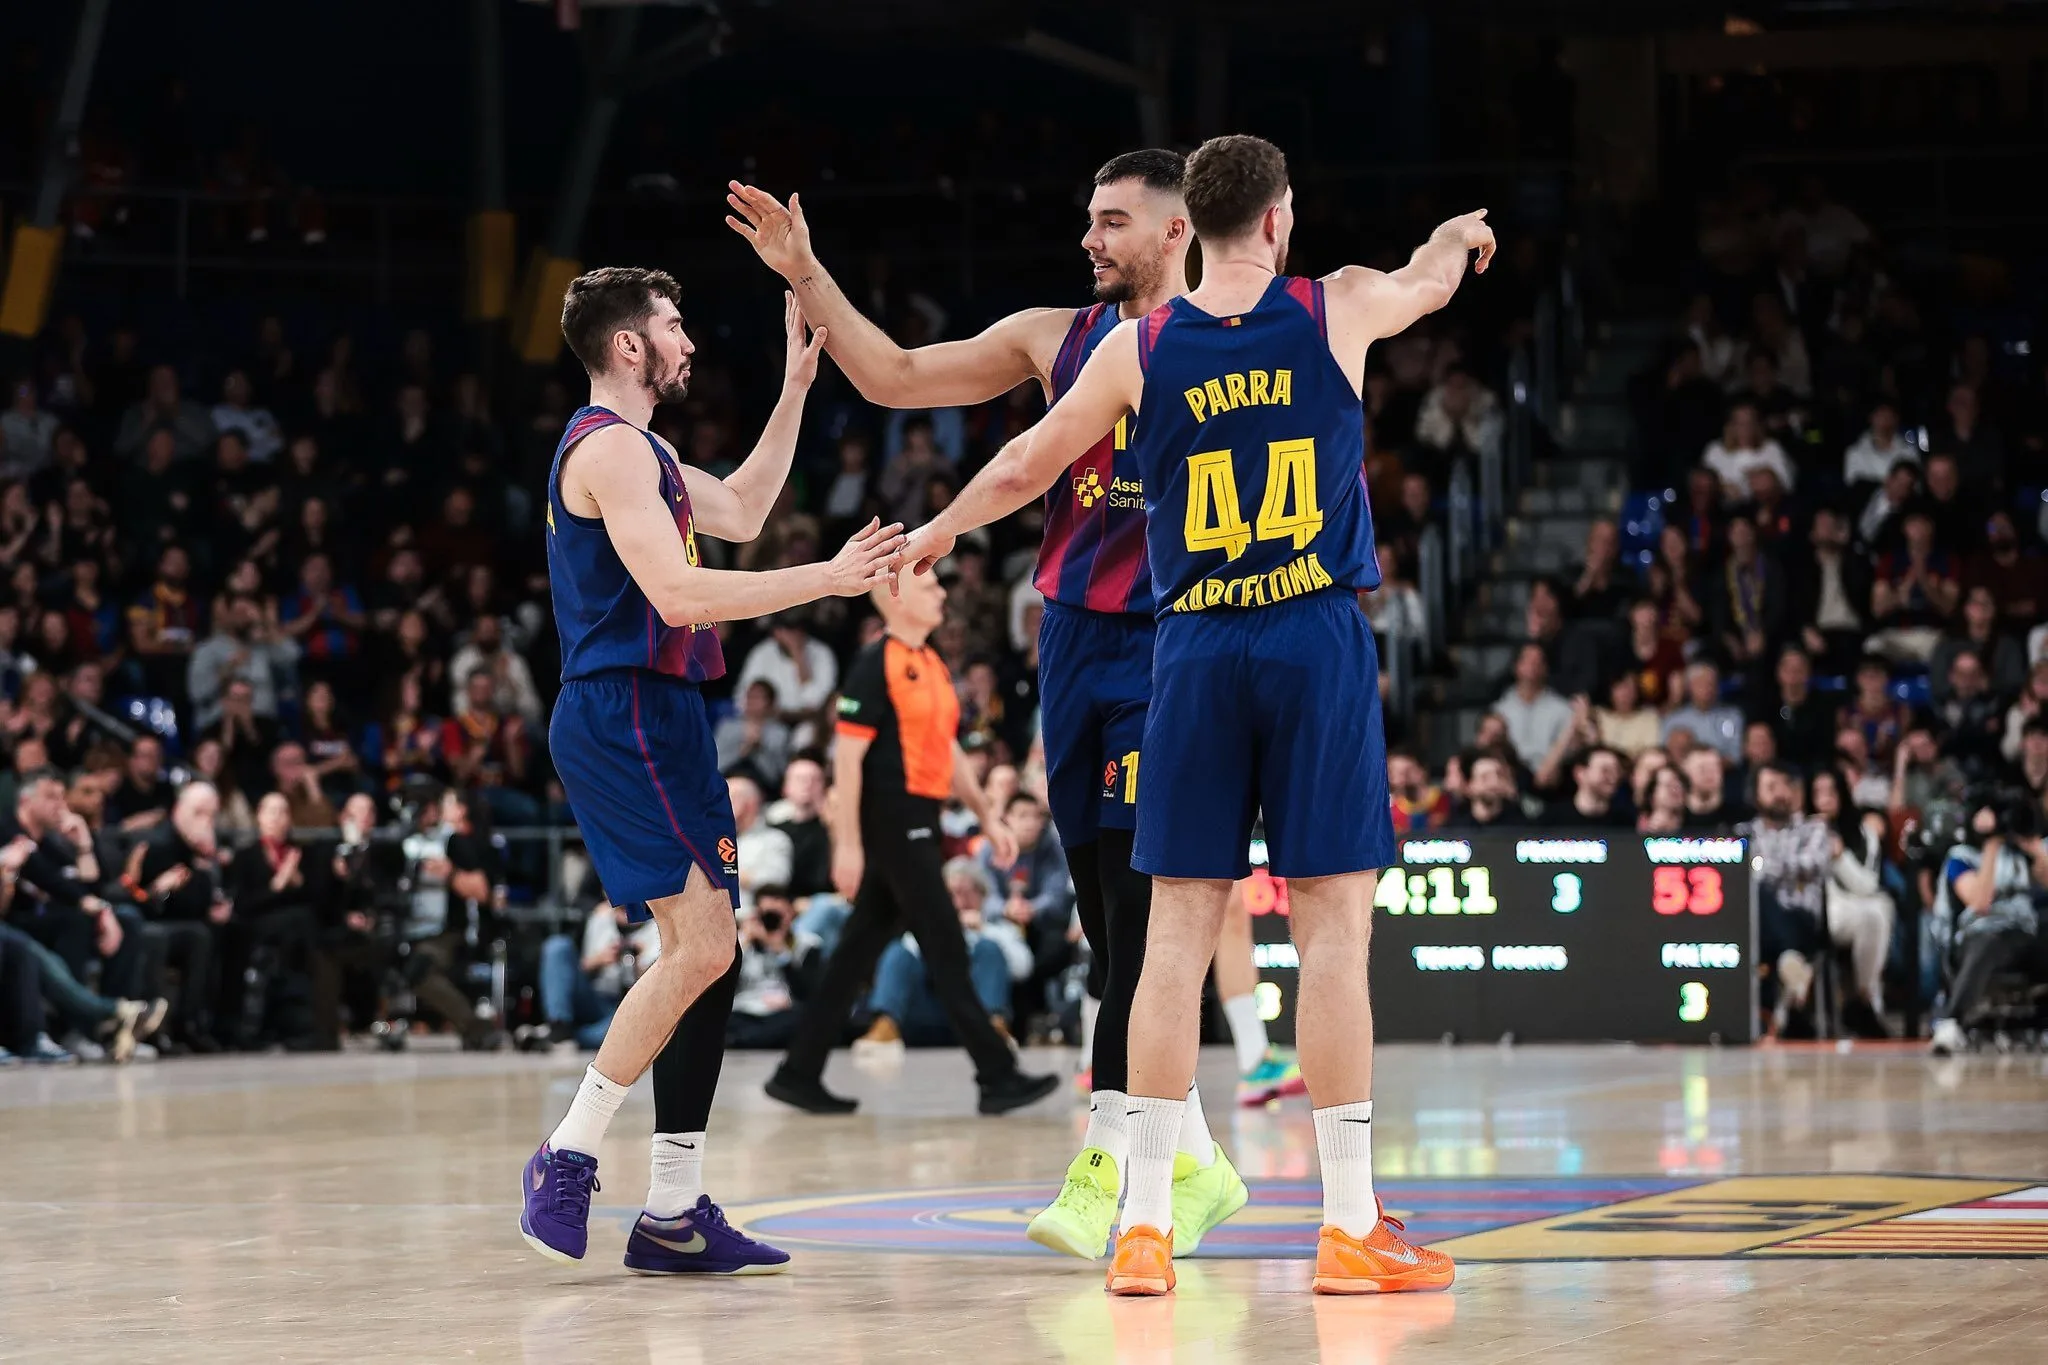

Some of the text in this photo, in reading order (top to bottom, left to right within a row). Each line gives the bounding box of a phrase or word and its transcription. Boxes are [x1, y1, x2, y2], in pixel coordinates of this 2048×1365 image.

[1183, 369, 1292, 424] PARRA
[1184, 438, 1324, 562] 44
[1122, 751, 1140, 804] 1
[1373, 866, 1498, 916] 4:11
[1551, 872, 1582, 913] 3
[1653, 866, 1724, 915] 53
[1678, 981, 1709, 1022] 3
